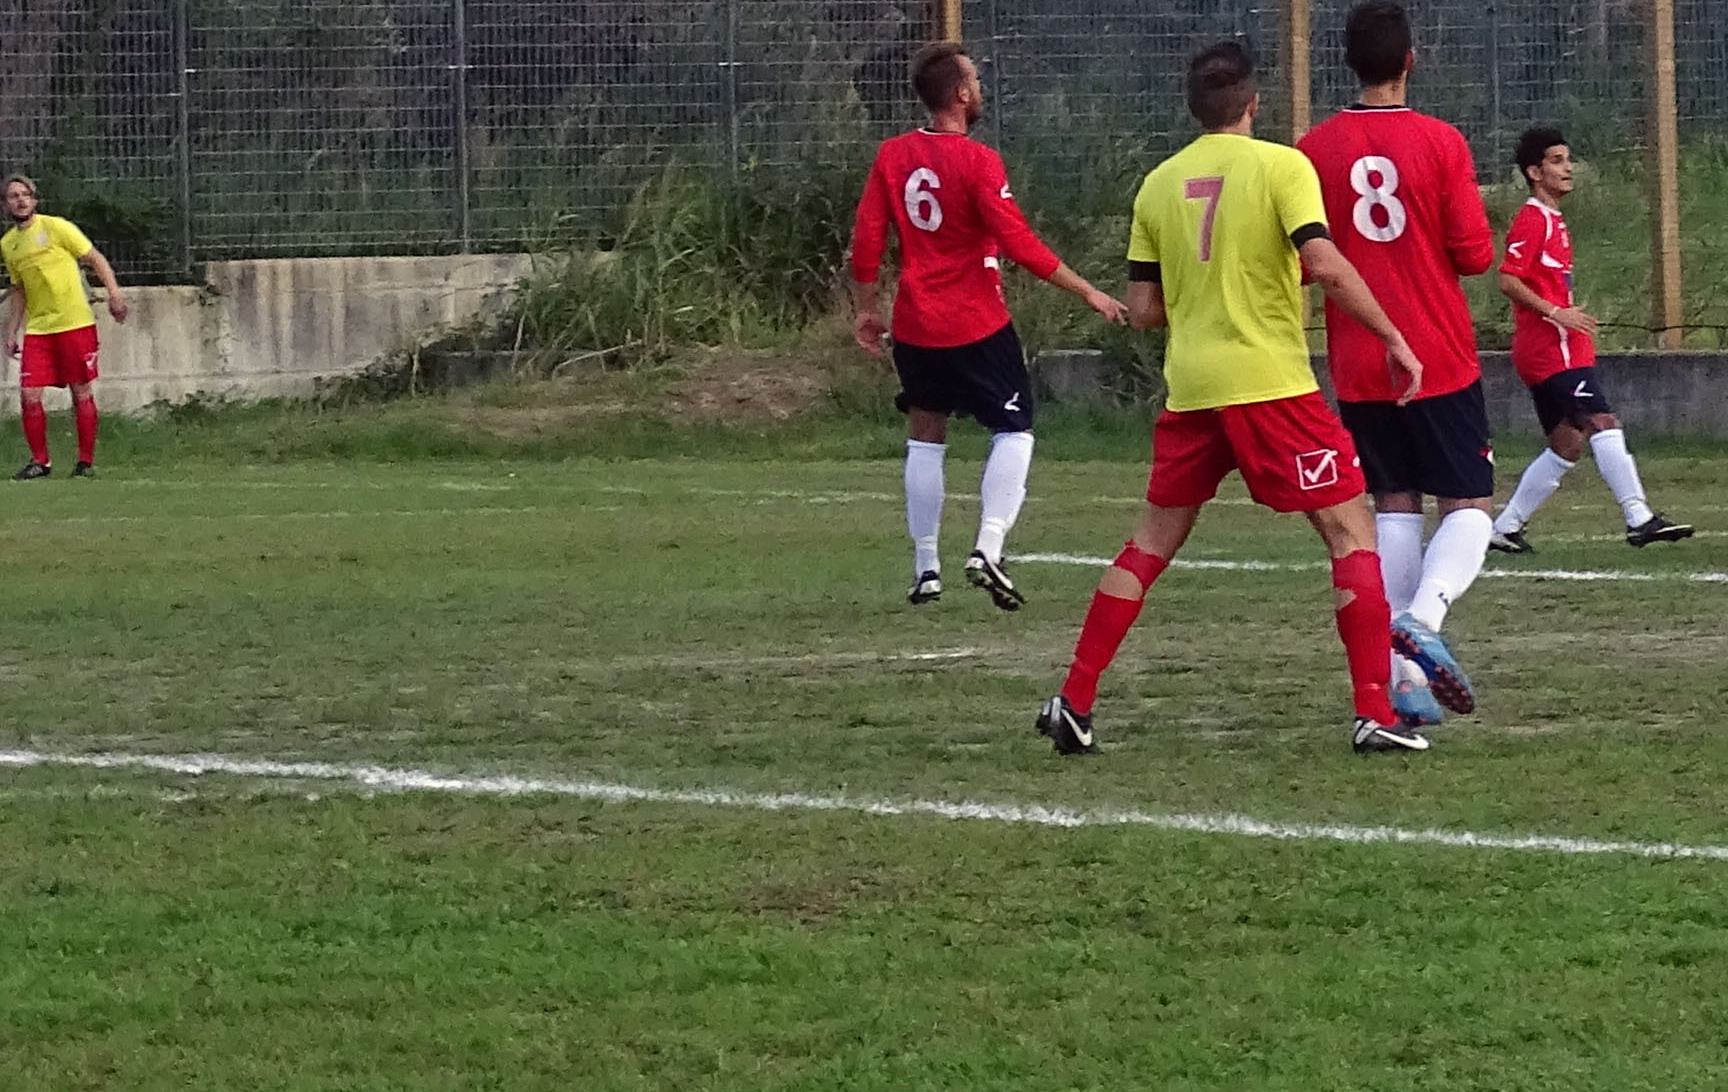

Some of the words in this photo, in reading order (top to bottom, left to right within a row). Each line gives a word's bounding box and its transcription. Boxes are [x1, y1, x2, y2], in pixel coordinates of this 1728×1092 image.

[904, 167, 943, 232] 6
[1185, 176, 1224, 262] 7
[1350, 155, 1406, 242] 8
